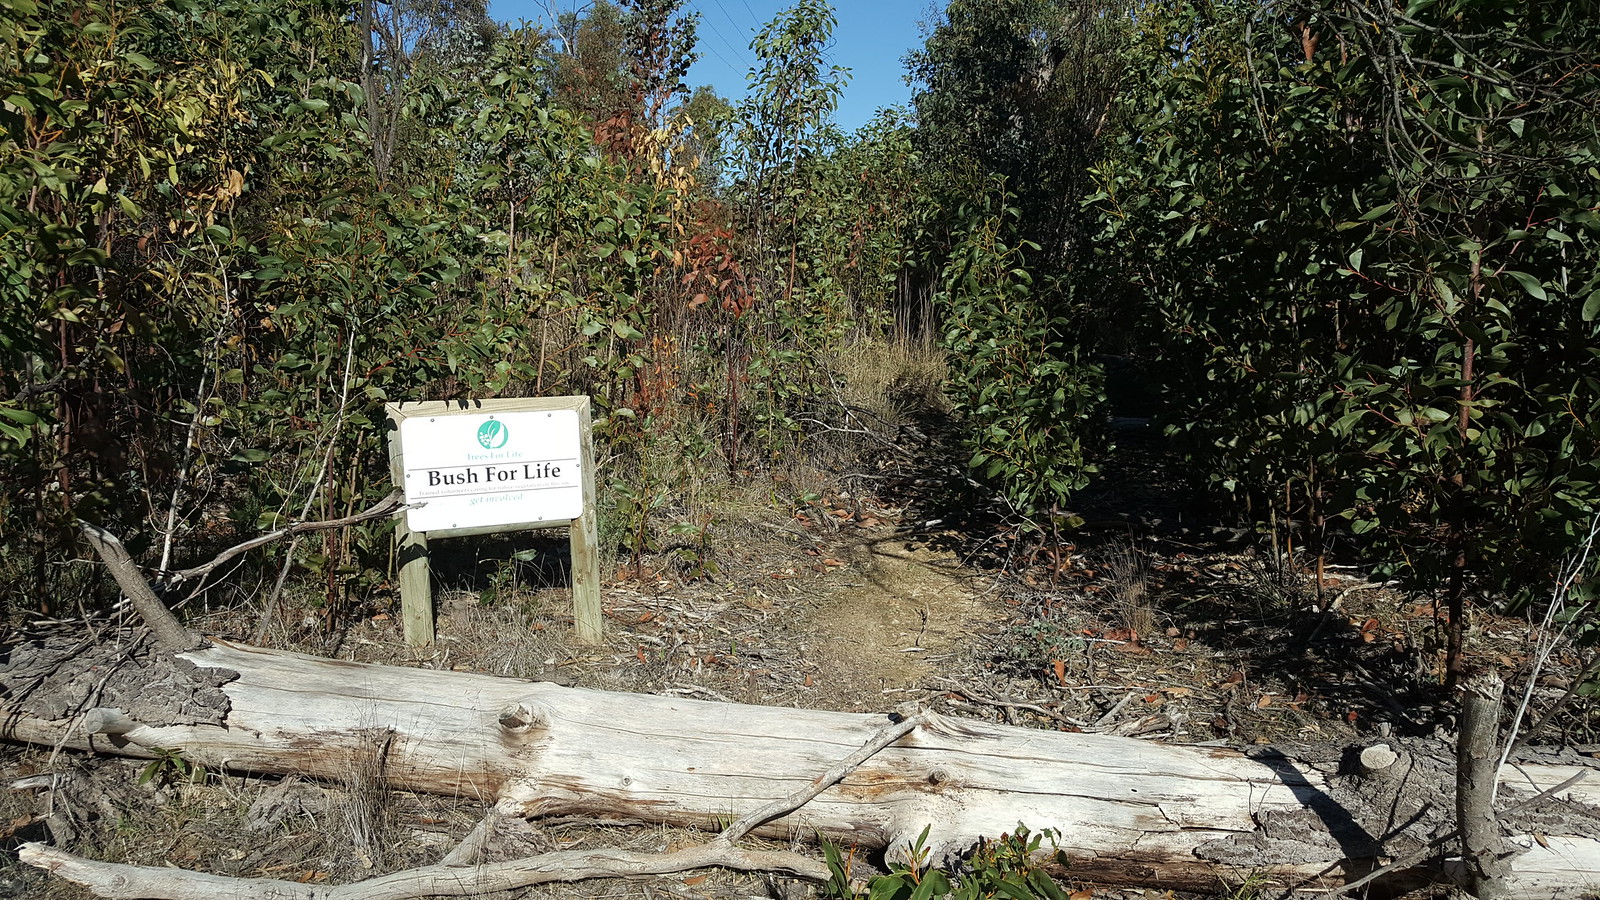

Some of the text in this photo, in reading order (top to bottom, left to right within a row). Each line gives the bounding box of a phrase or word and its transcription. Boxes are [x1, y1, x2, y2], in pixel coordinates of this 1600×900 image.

[466, 449, 525, 461] Trees For Life
[428, 462, 561, 487] Bush For Life
[469, 493, 523, 507] get involved
